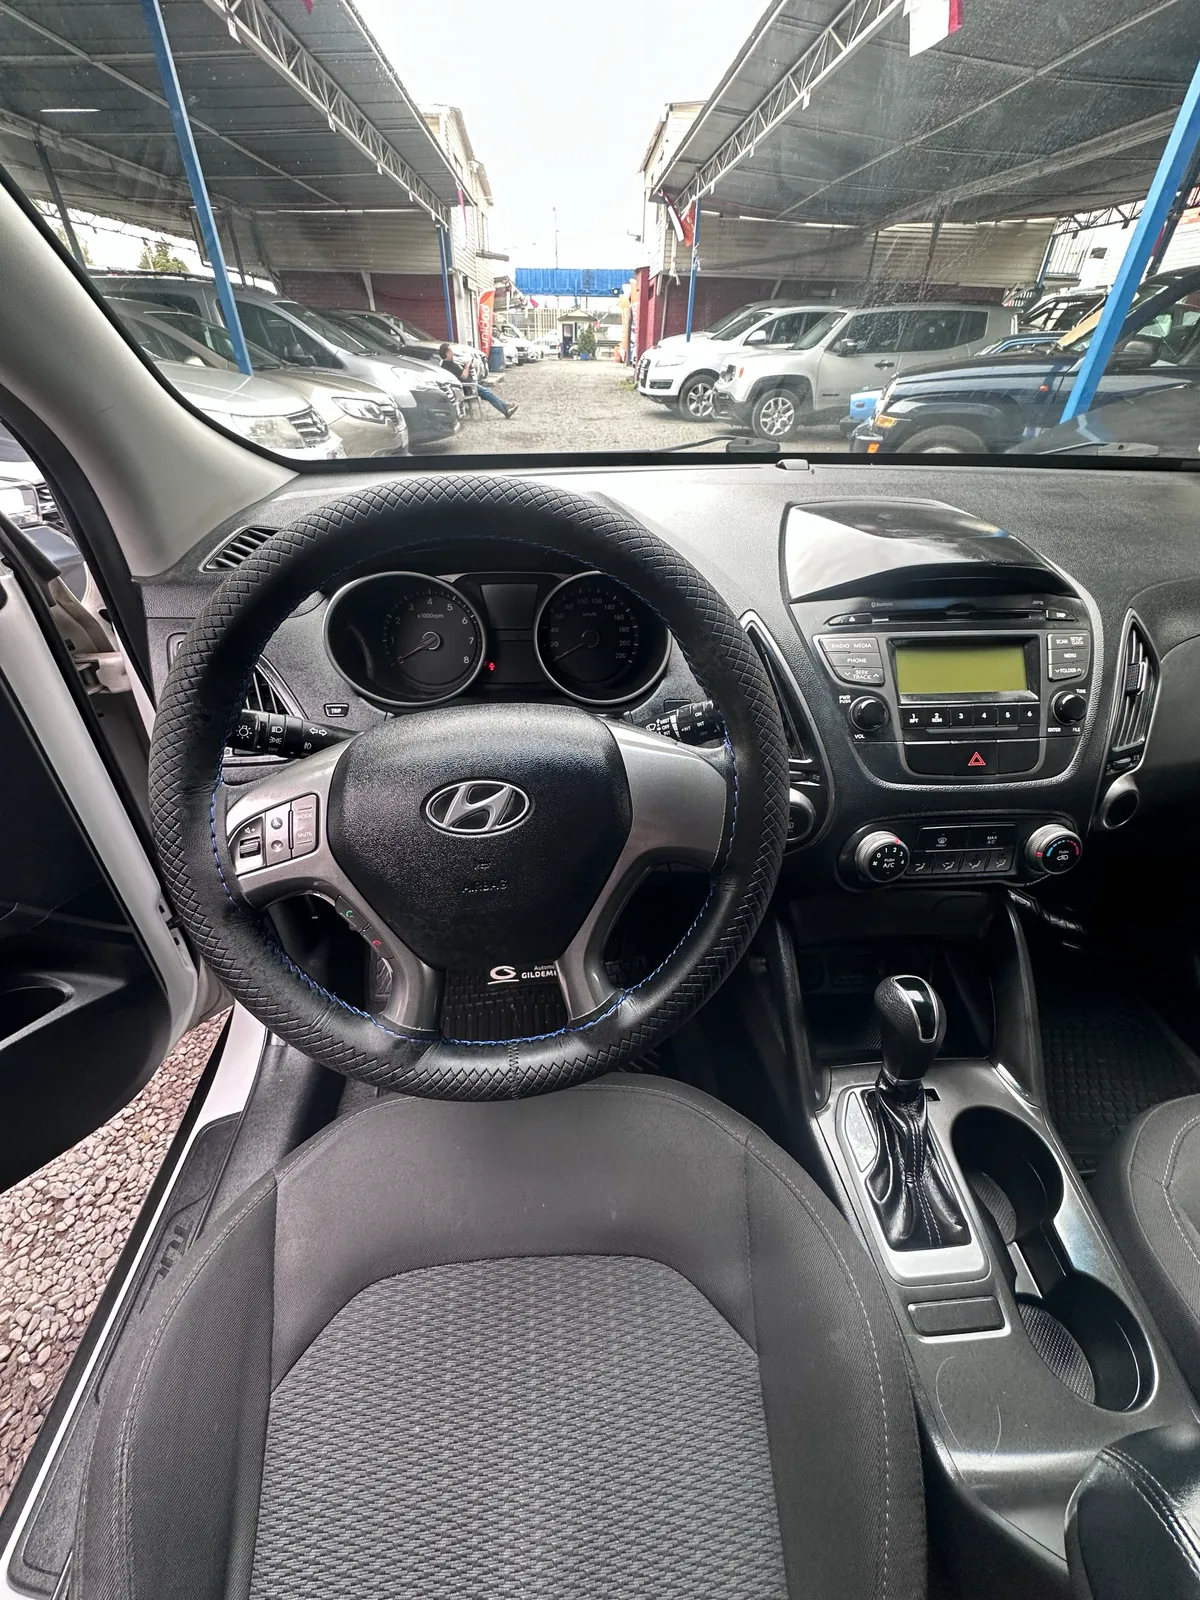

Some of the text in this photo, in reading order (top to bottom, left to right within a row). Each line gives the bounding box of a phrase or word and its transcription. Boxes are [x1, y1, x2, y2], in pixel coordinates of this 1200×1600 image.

[480, 303, 490, 349] unidad
[408, 603, 414, 611] 3
[446, 603, 453, 611] 5
[394, 617, 401, 625] 2
[468, 637, 474, 645] 7
[463, 656, 470, 664] 8
